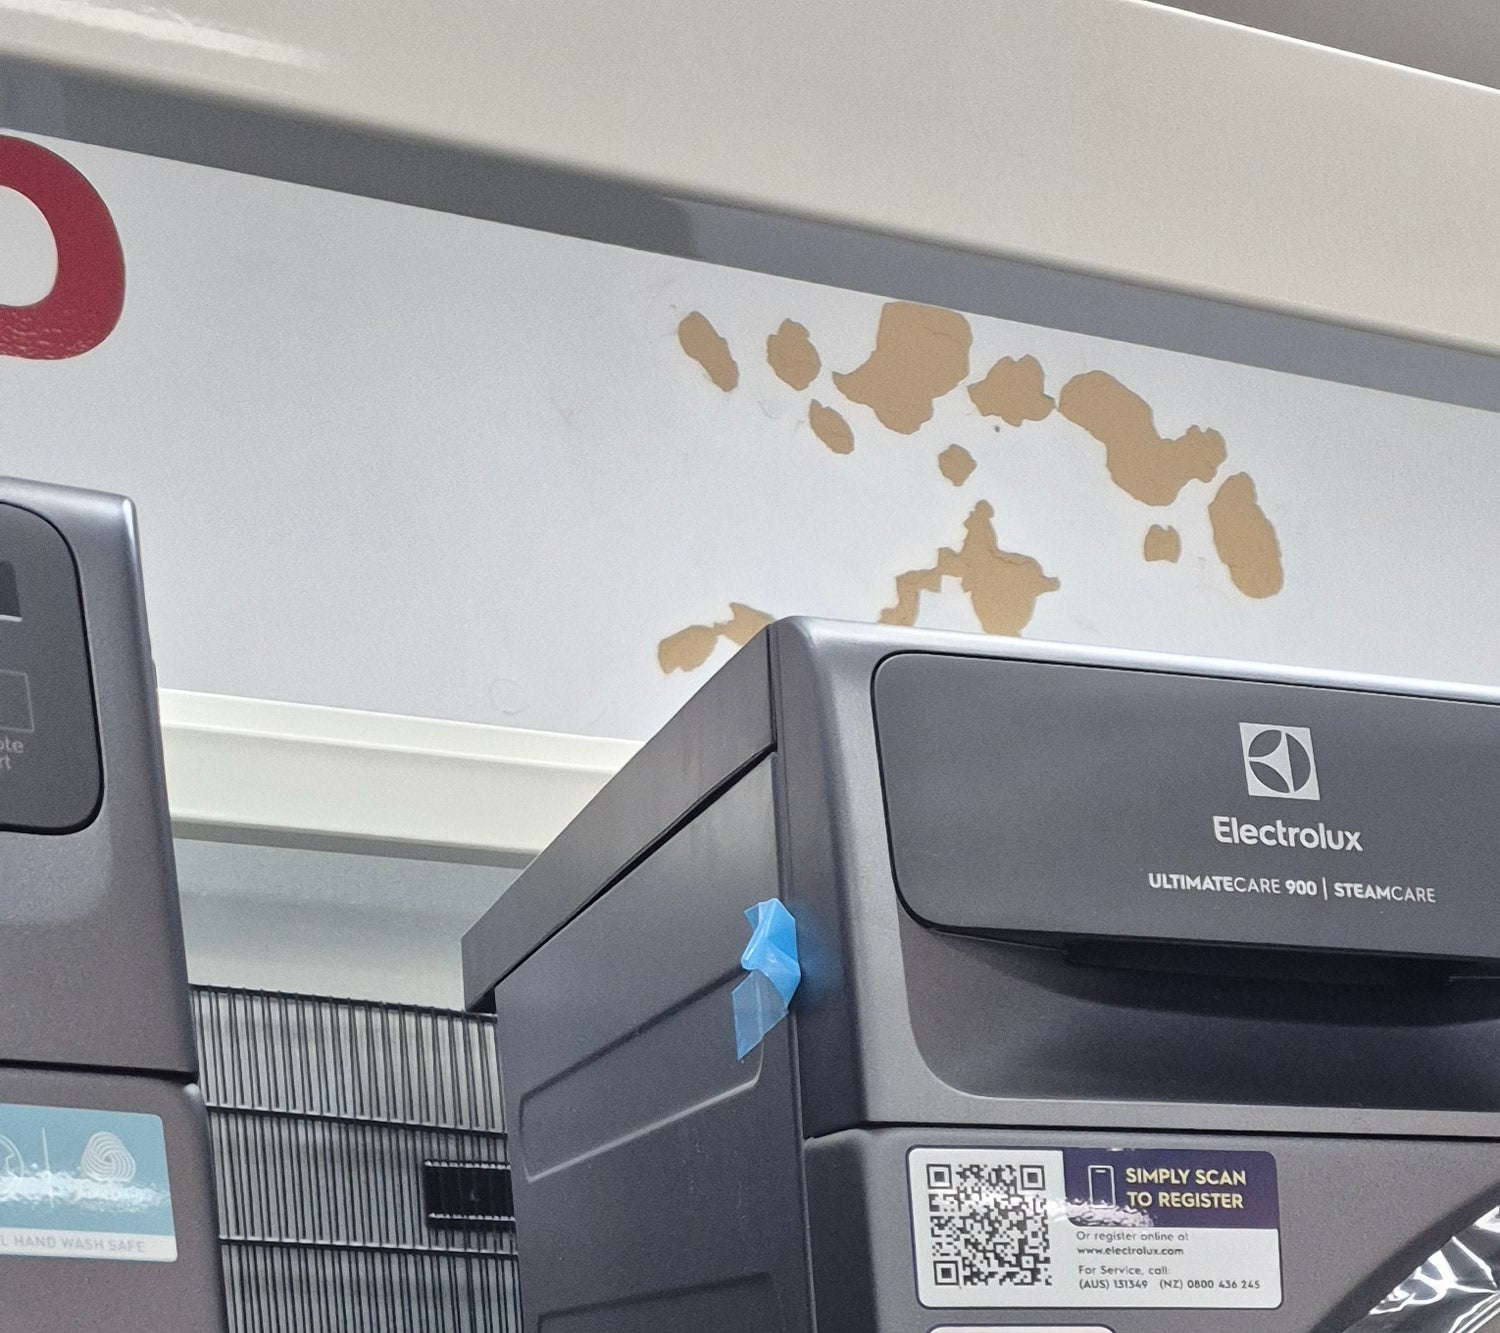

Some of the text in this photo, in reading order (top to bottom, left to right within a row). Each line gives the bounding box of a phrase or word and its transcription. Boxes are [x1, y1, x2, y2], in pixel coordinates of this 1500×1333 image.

[1212, 816, 1363, 851] Electrolux
[1148, 873, 1280, 894] ULTIMATECARE
[1285, 880, 1317, 896] 900
[1334, 882, 1436, 903] STEAMCARE
[1126, 1168, 1246, 1186] SIMPLY SCAN
[1128, 1191, 1243, 1209] TO REGISTER
[14, 1235, 56, 1248] HAND
[61, 1238, 103, 1250] WASH
[108, 1239, 145, 1252] SAFE
[1076, 1231, 1189, 1242] Or register online at
[1077, 1247, 1184, 1256] www.electrolux.com
[1078, 1266, 1096, 1274] For
[1100, 1266, 1144, 1275] Service,
[1079, 1279, 1148, 1289] (AUS) 131349
[1160, 1280, 1260, 1290] (NZ) 0800 436 245
